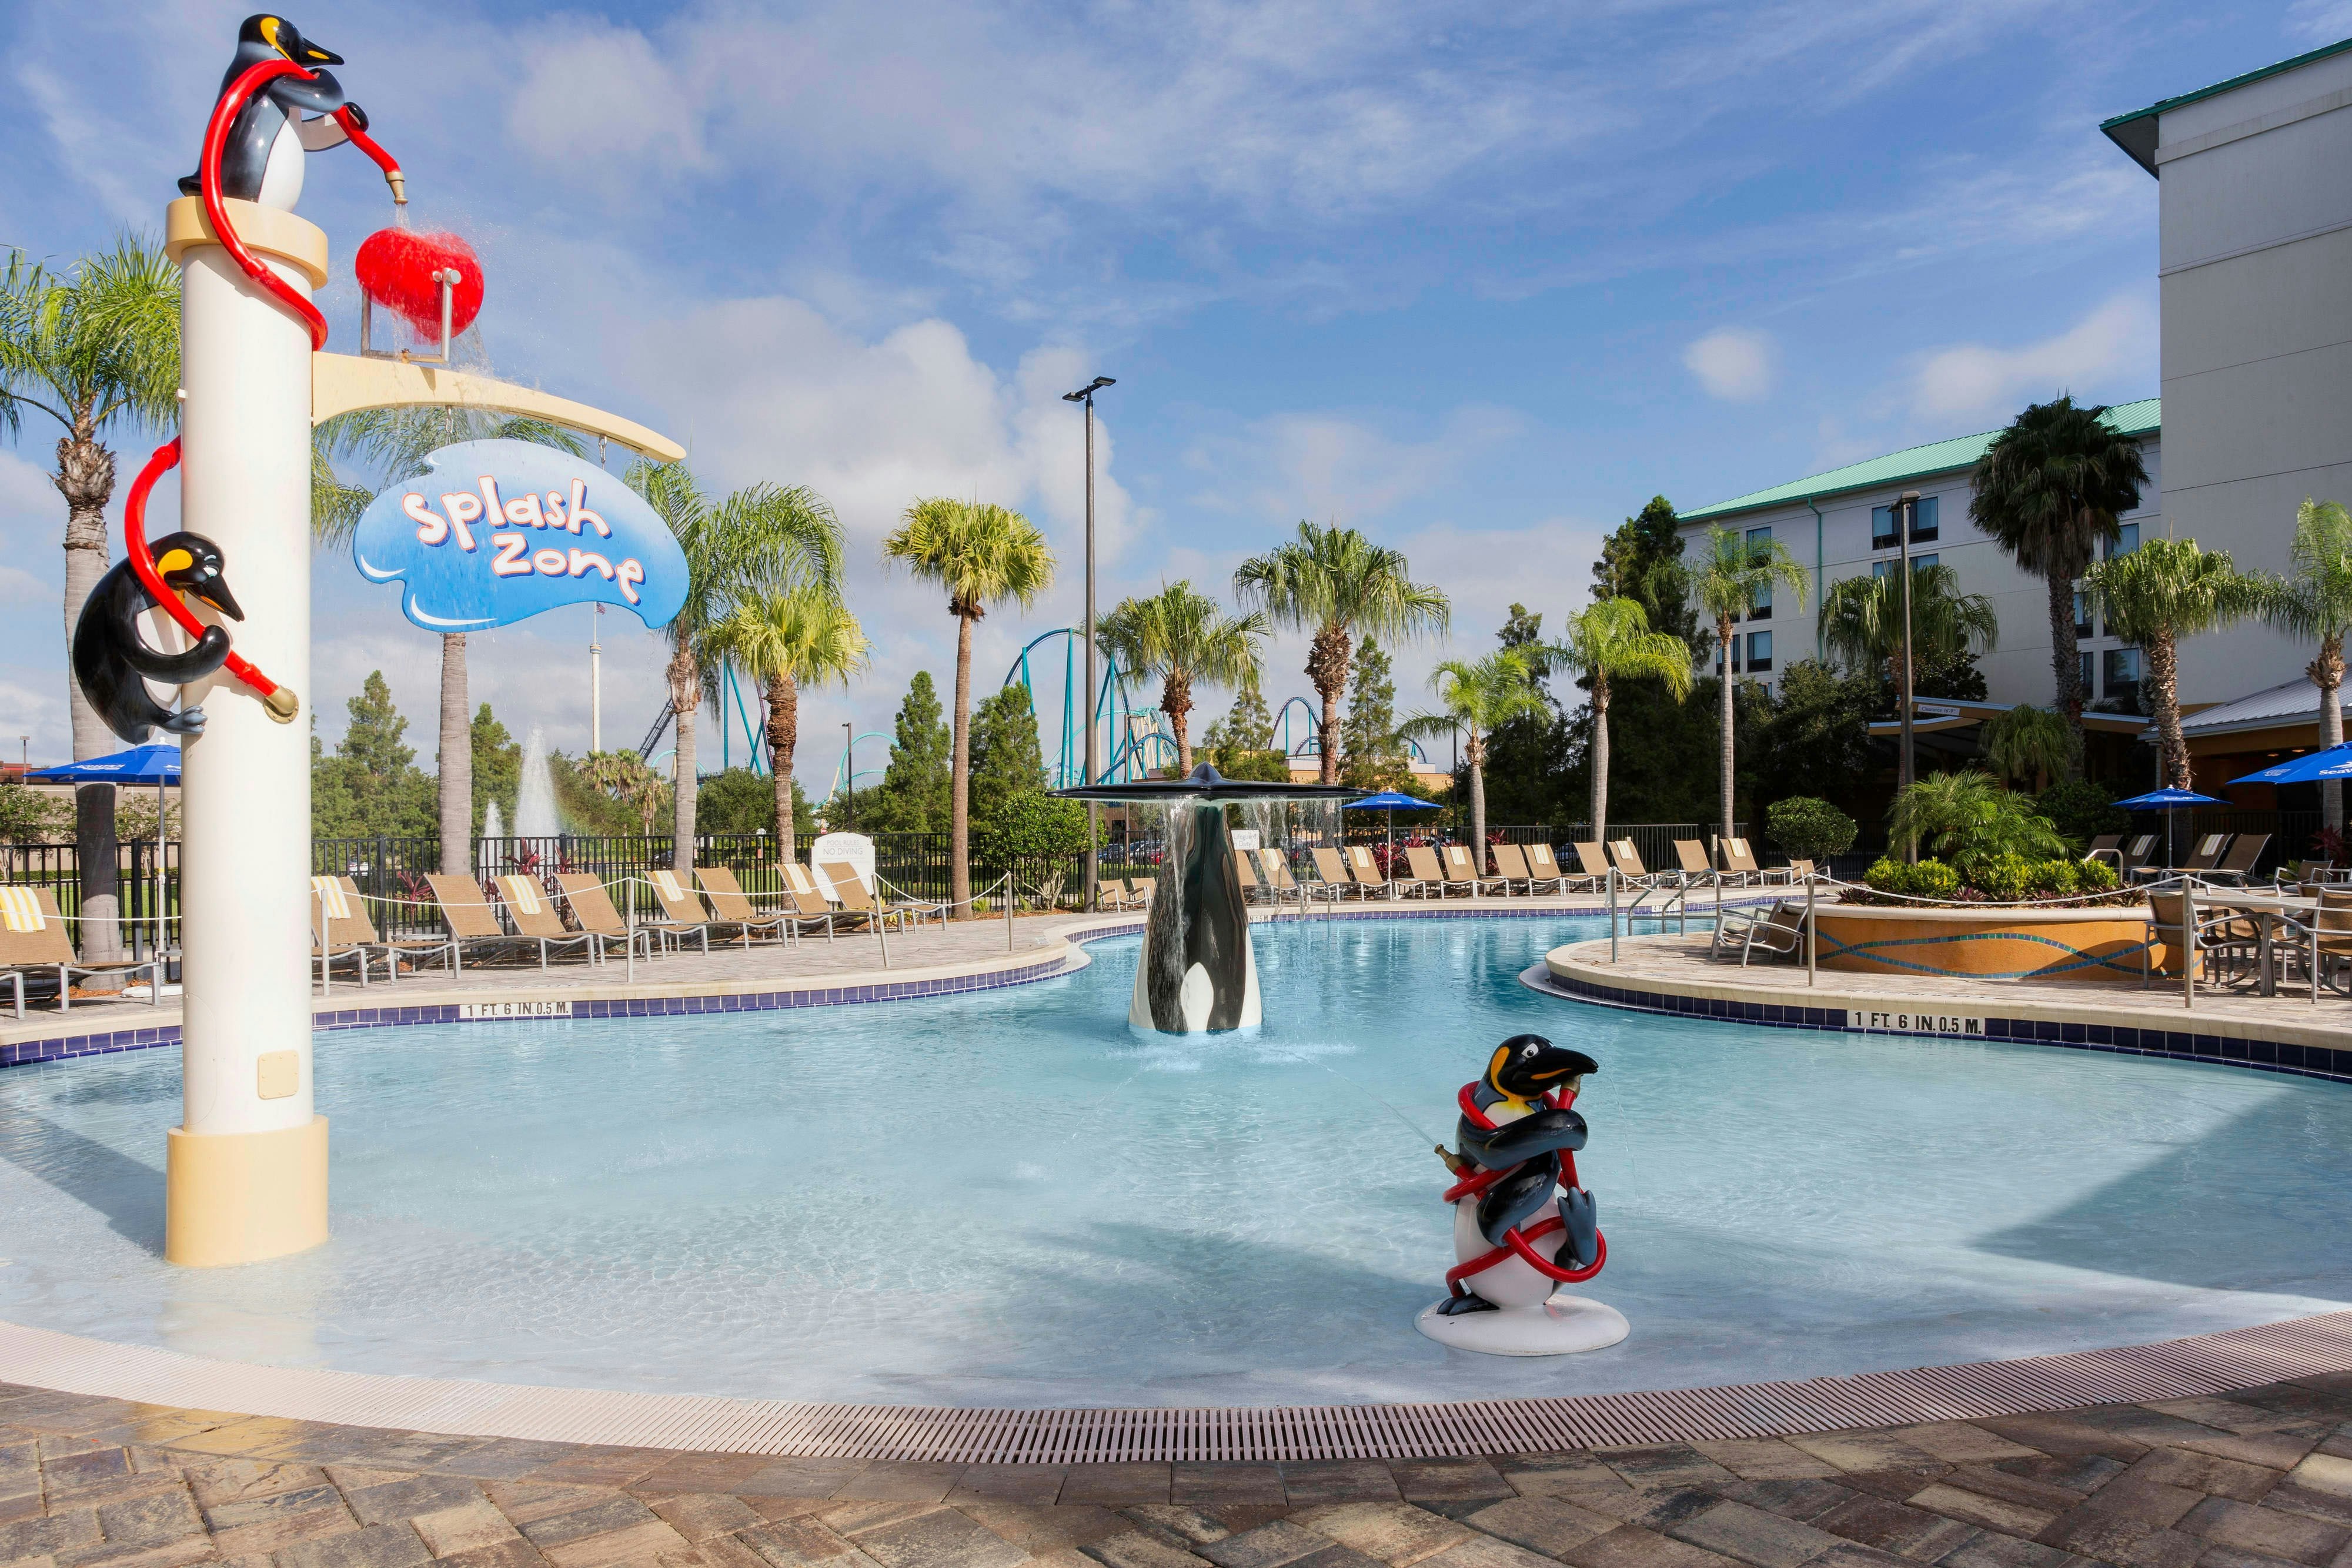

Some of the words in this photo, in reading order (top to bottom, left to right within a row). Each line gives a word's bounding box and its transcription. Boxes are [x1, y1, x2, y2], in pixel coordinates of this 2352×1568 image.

[402, 475, 611, 554] Splash
[492, 532, 646, 607] Zone
[837, 847, 863, 855] DIVING
[467, 1005, 473, 1017] 1
[504, 1003, 511, 1015] 6
[536, 1002, 552, 1014] 0.5
[1855, 1011, 1862, 1026] 1
[1898, 1014, 1907, 1028] 6
[1939, 1017, 1959, 1032] 0.5
